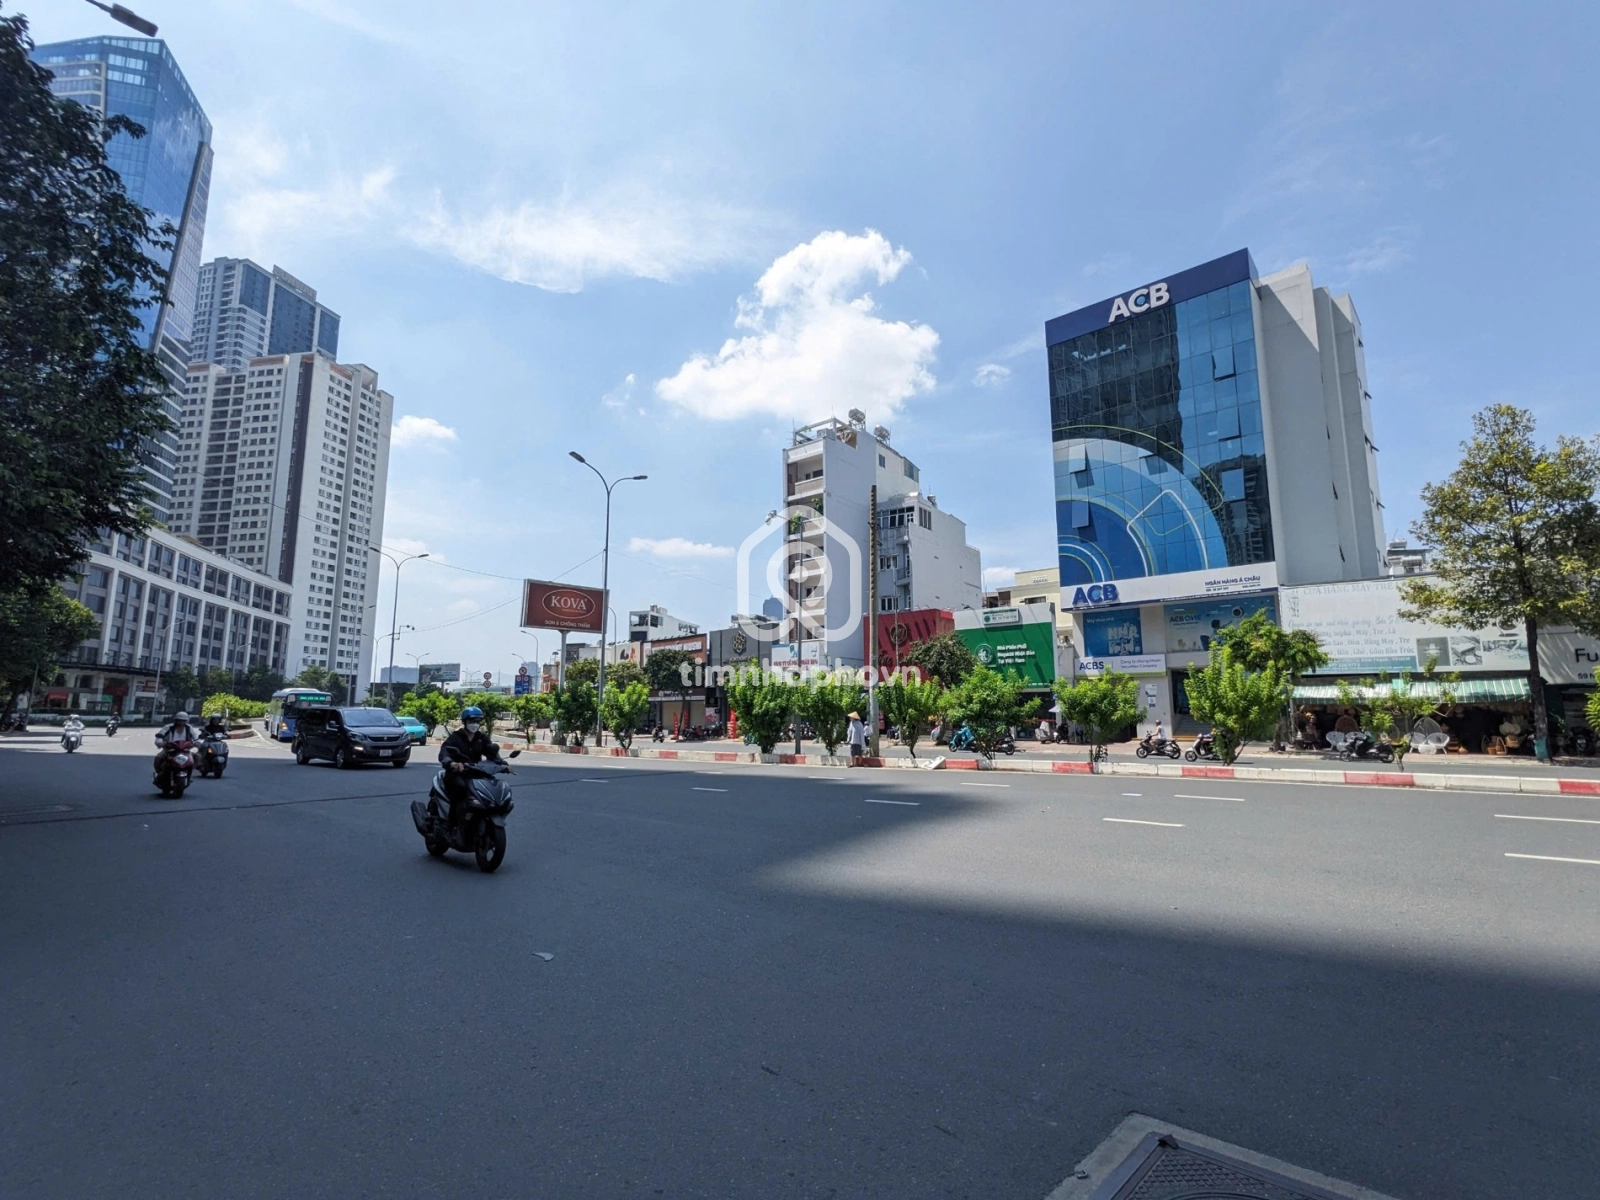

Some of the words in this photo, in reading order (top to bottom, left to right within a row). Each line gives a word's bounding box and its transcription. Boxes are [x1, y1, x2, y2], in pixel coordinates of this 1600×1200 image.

[1108, 282, 1170, 324] ACB
[550, 595, 587, 610] KOVA
[1071, 583, 1118, 606] ACB
[1079, 661, 1105, 671] ACBS
